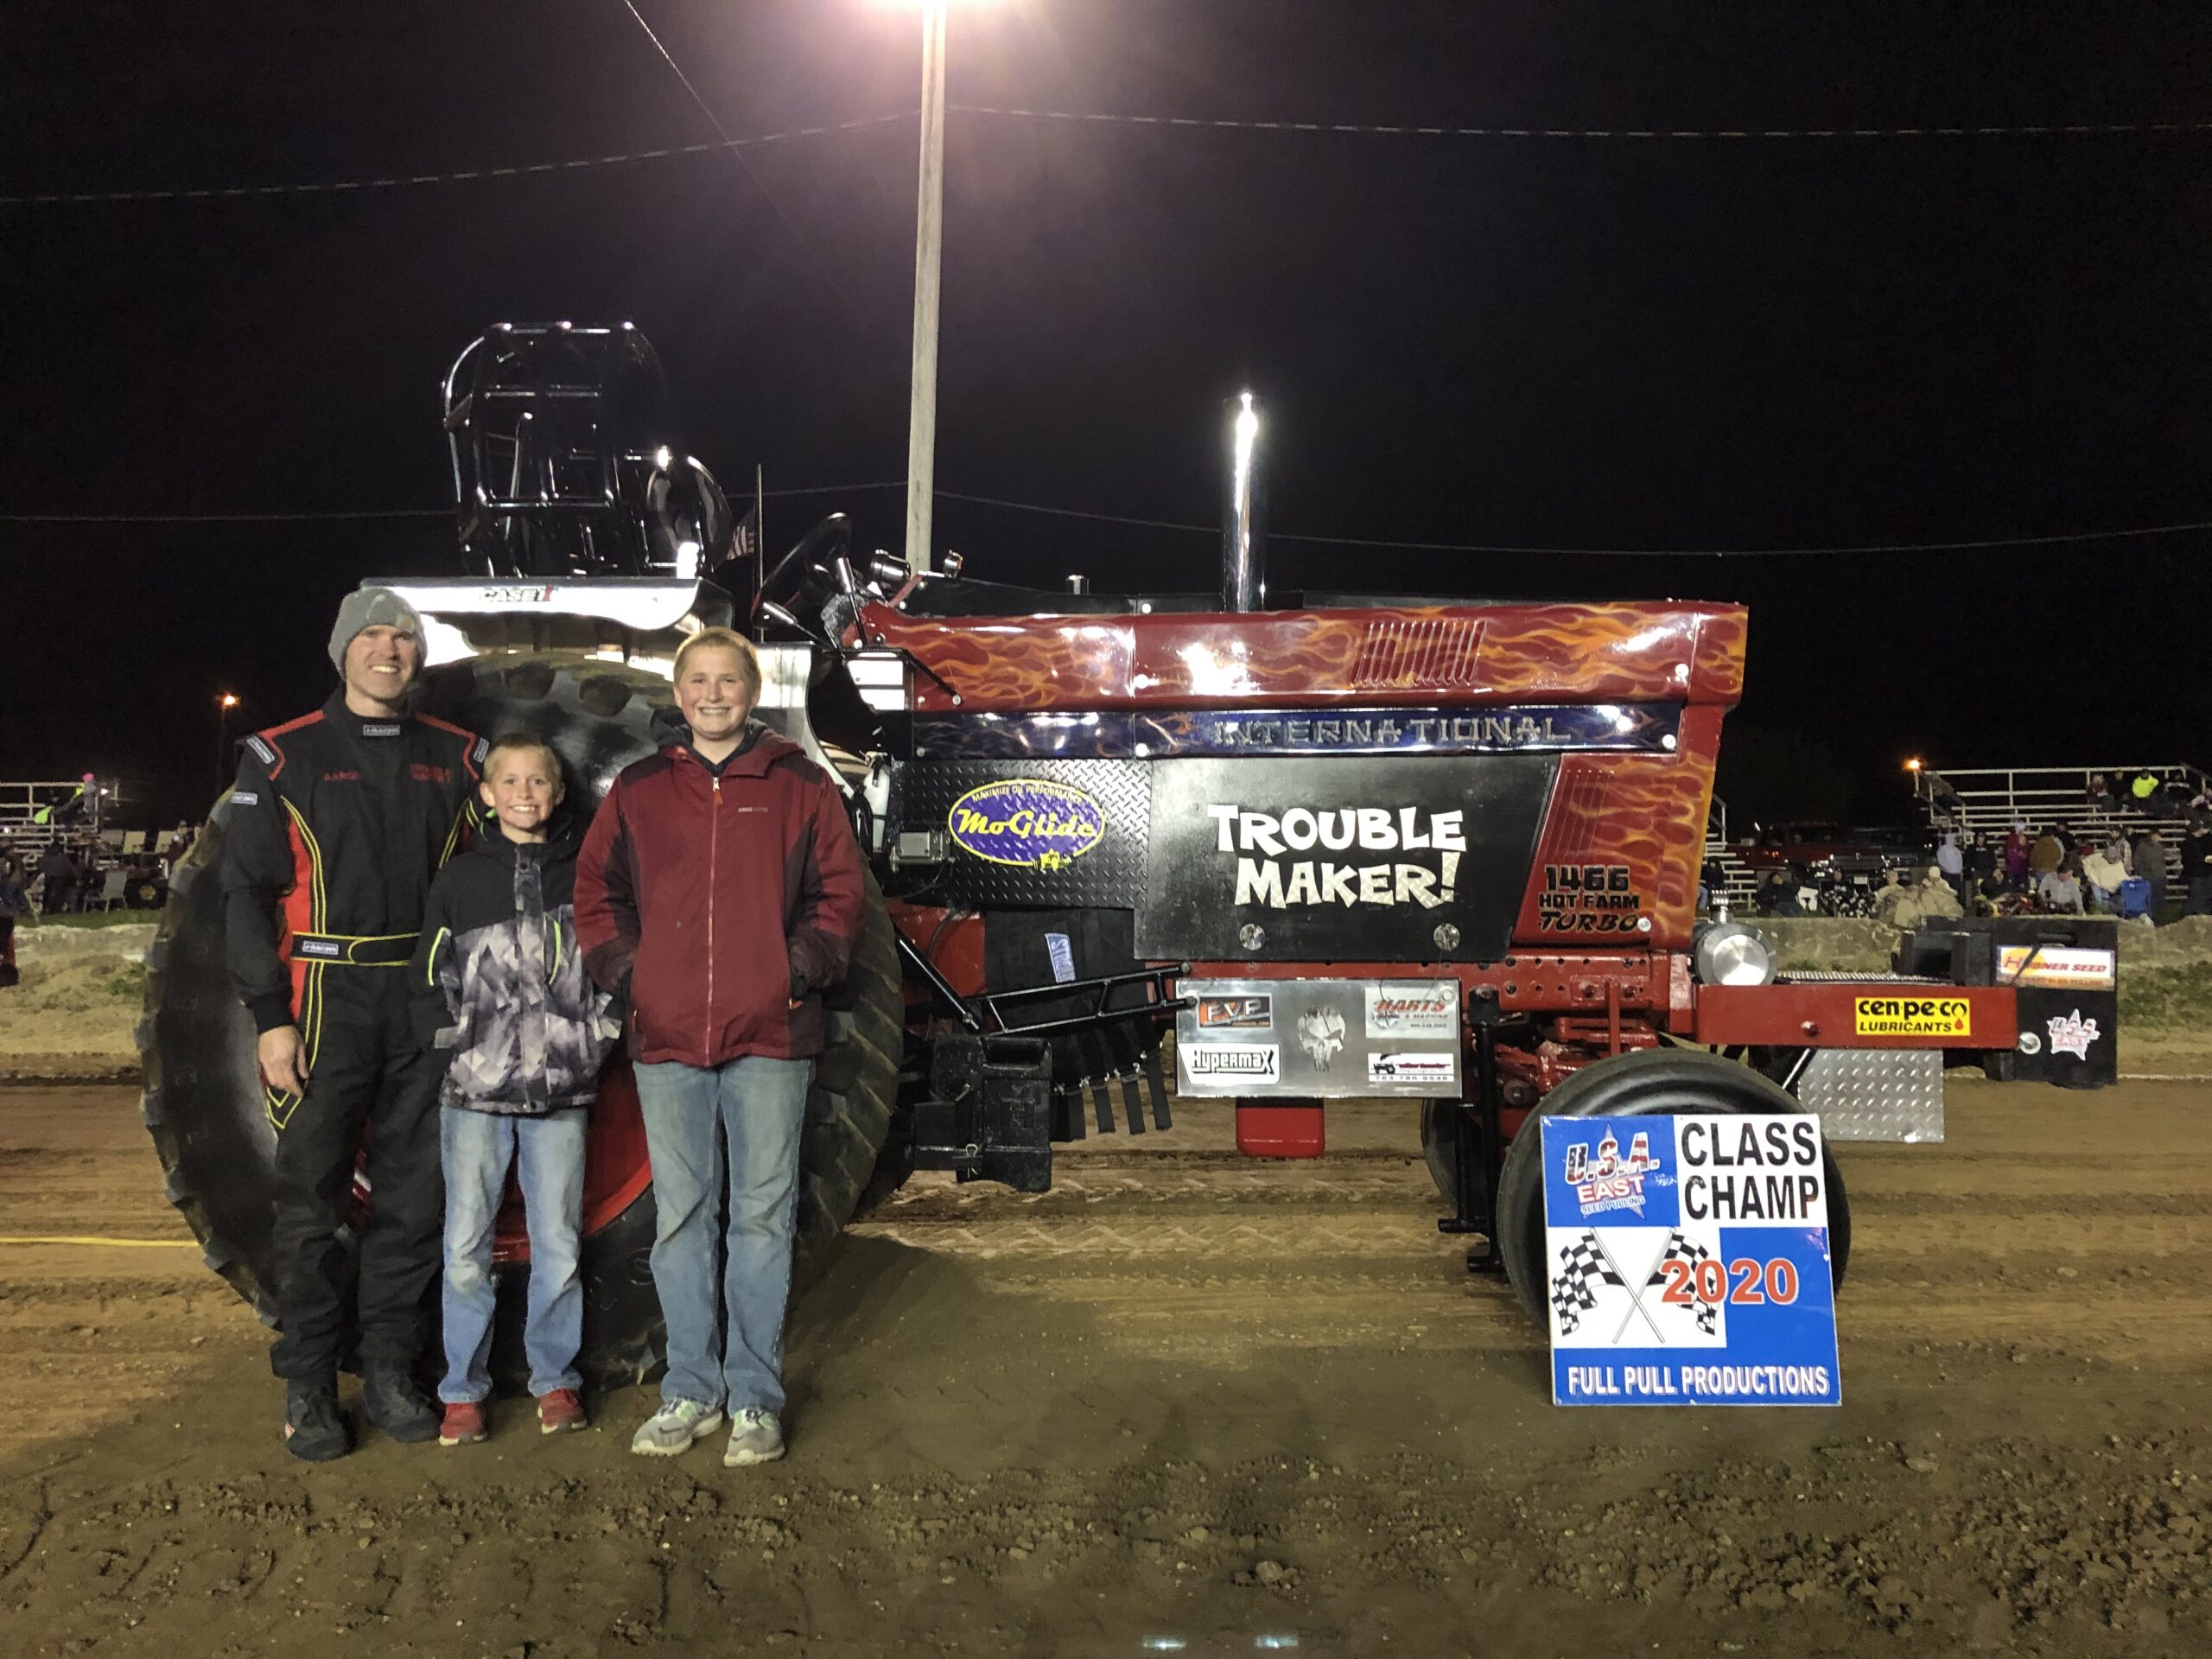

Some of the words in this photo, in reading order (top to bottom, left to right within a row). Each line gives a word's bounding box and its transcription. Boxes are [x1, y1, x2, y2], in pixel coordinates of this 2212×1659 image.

[1213, 717, 1571, 745] INTERNATIONAL
[971, 785, 1010, 804] MAXIMIZE
[957, 809, 1097, 839] MoGlide
[1207, 804, 1467, 856] TROUBLE
[1234, 851, 1461, 910] MAKER!
[1544, 865, 1630, 893] 1466
[1535, 893, 1579, 910] HOT
[1582, 893, 1640, 911] FARM
[1538, 911, 1641, 933] TURBO
[2071, 963, 2107, 973] SEED
[1206, 998, 1262, 1021] FVP
[1859, 1020, 1953, 1033] LUBRICANTS
[1681, 1122, 1817, 1167] CLASS
[1577, 1174, 1645, 1205] EAST
[1605, 1195, 1646, 1211] PULLING
[1684, 1174, 1820, 1221] CHAMP
[1659, 1258, 1799, 1305] 2020
[1567, 1366, 1621, 1395] FULL
[1624, 1366, 1679, 1395] PULL
[1681, 1366, 1829, 1395] PRODUCTIONS
